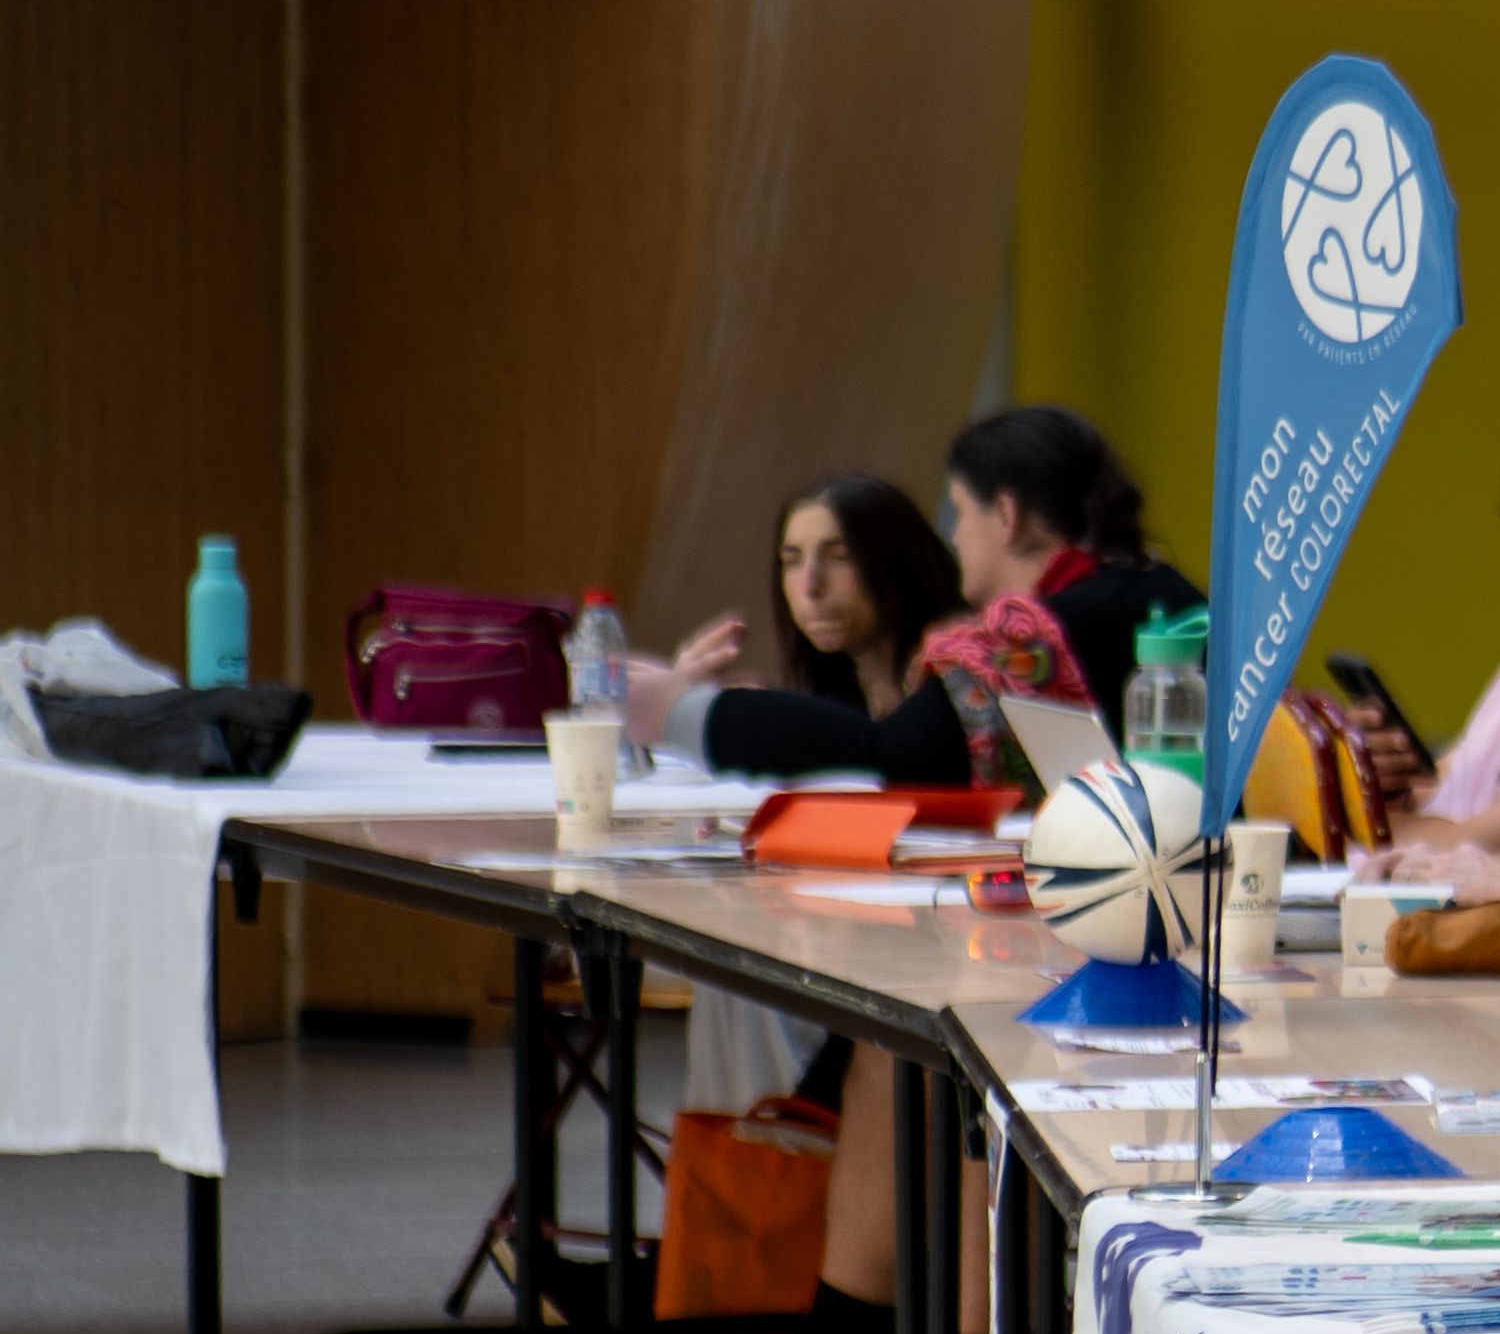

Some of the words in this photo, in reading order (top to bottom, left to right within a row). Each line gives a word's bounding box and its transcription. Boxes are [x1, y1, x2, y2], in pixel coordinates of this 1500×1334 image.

[1241, 416, 1297, 524] mon
[1253, 426, 1336, 583] réseau
[1227, 592, 1295, 743] cancer
[1290, 386, 1403, 593] COLORECTAL
